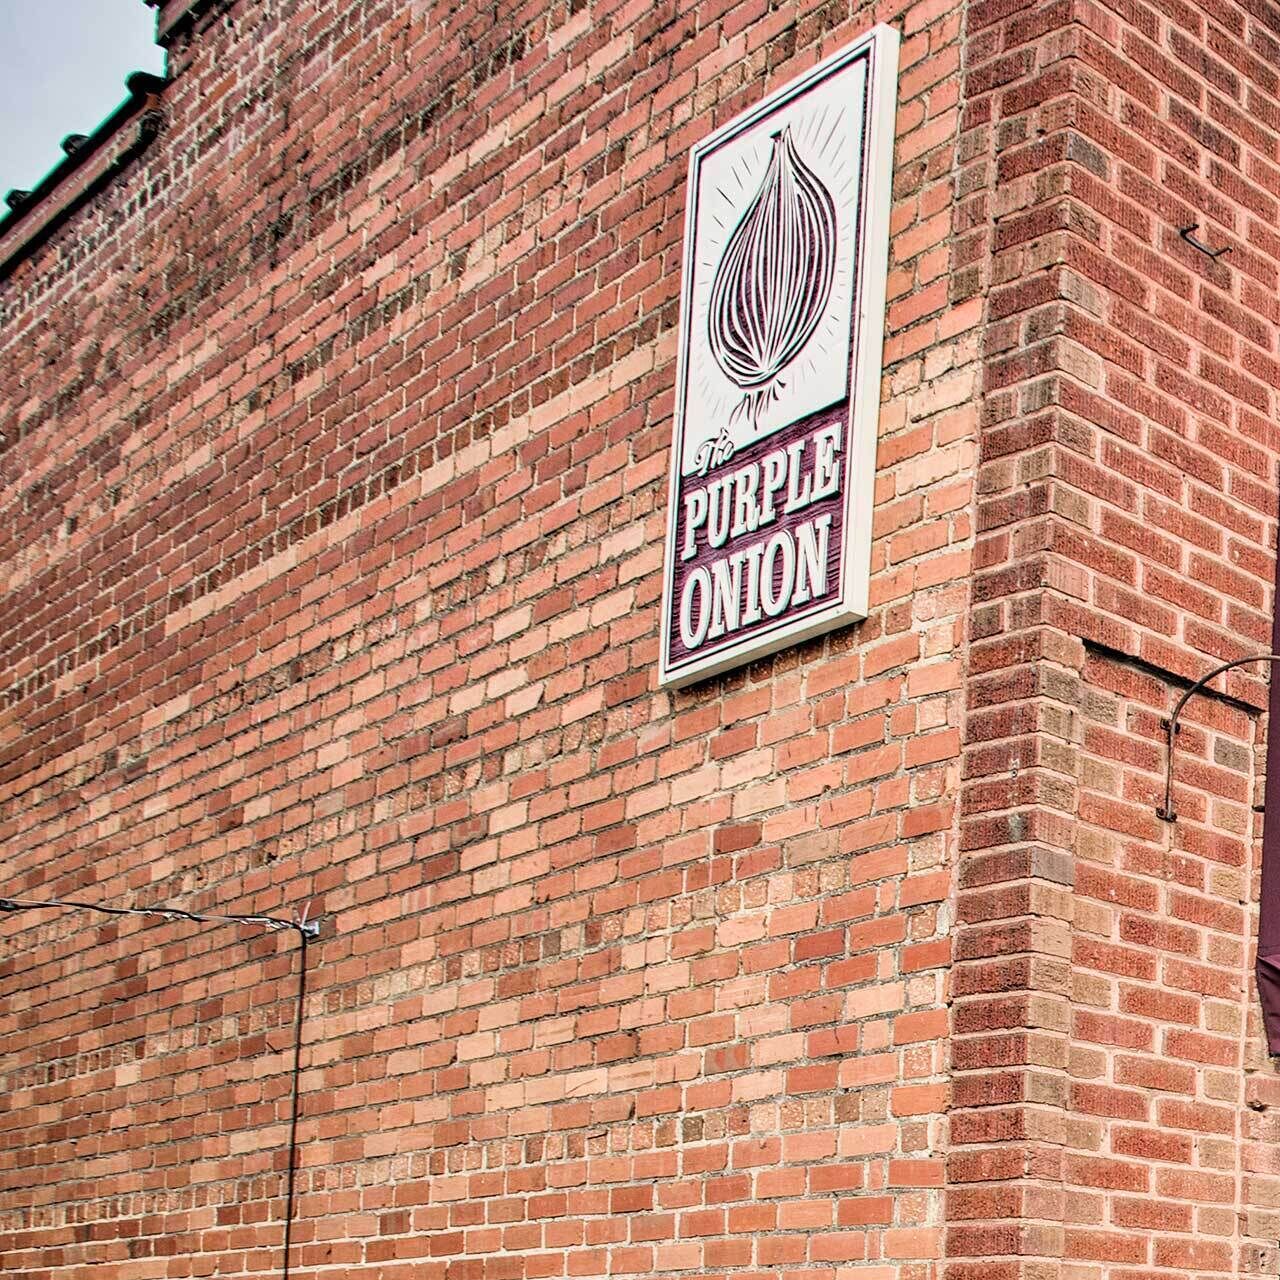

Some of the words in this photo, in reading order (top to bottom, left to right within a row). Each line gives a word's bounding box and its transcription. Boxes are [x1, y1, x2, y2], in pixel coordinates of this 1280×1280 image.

[683, 422, 843, 563] PURPLE
[694, 428, 735, 478] The
[680, 513, 833, 651] ONION
